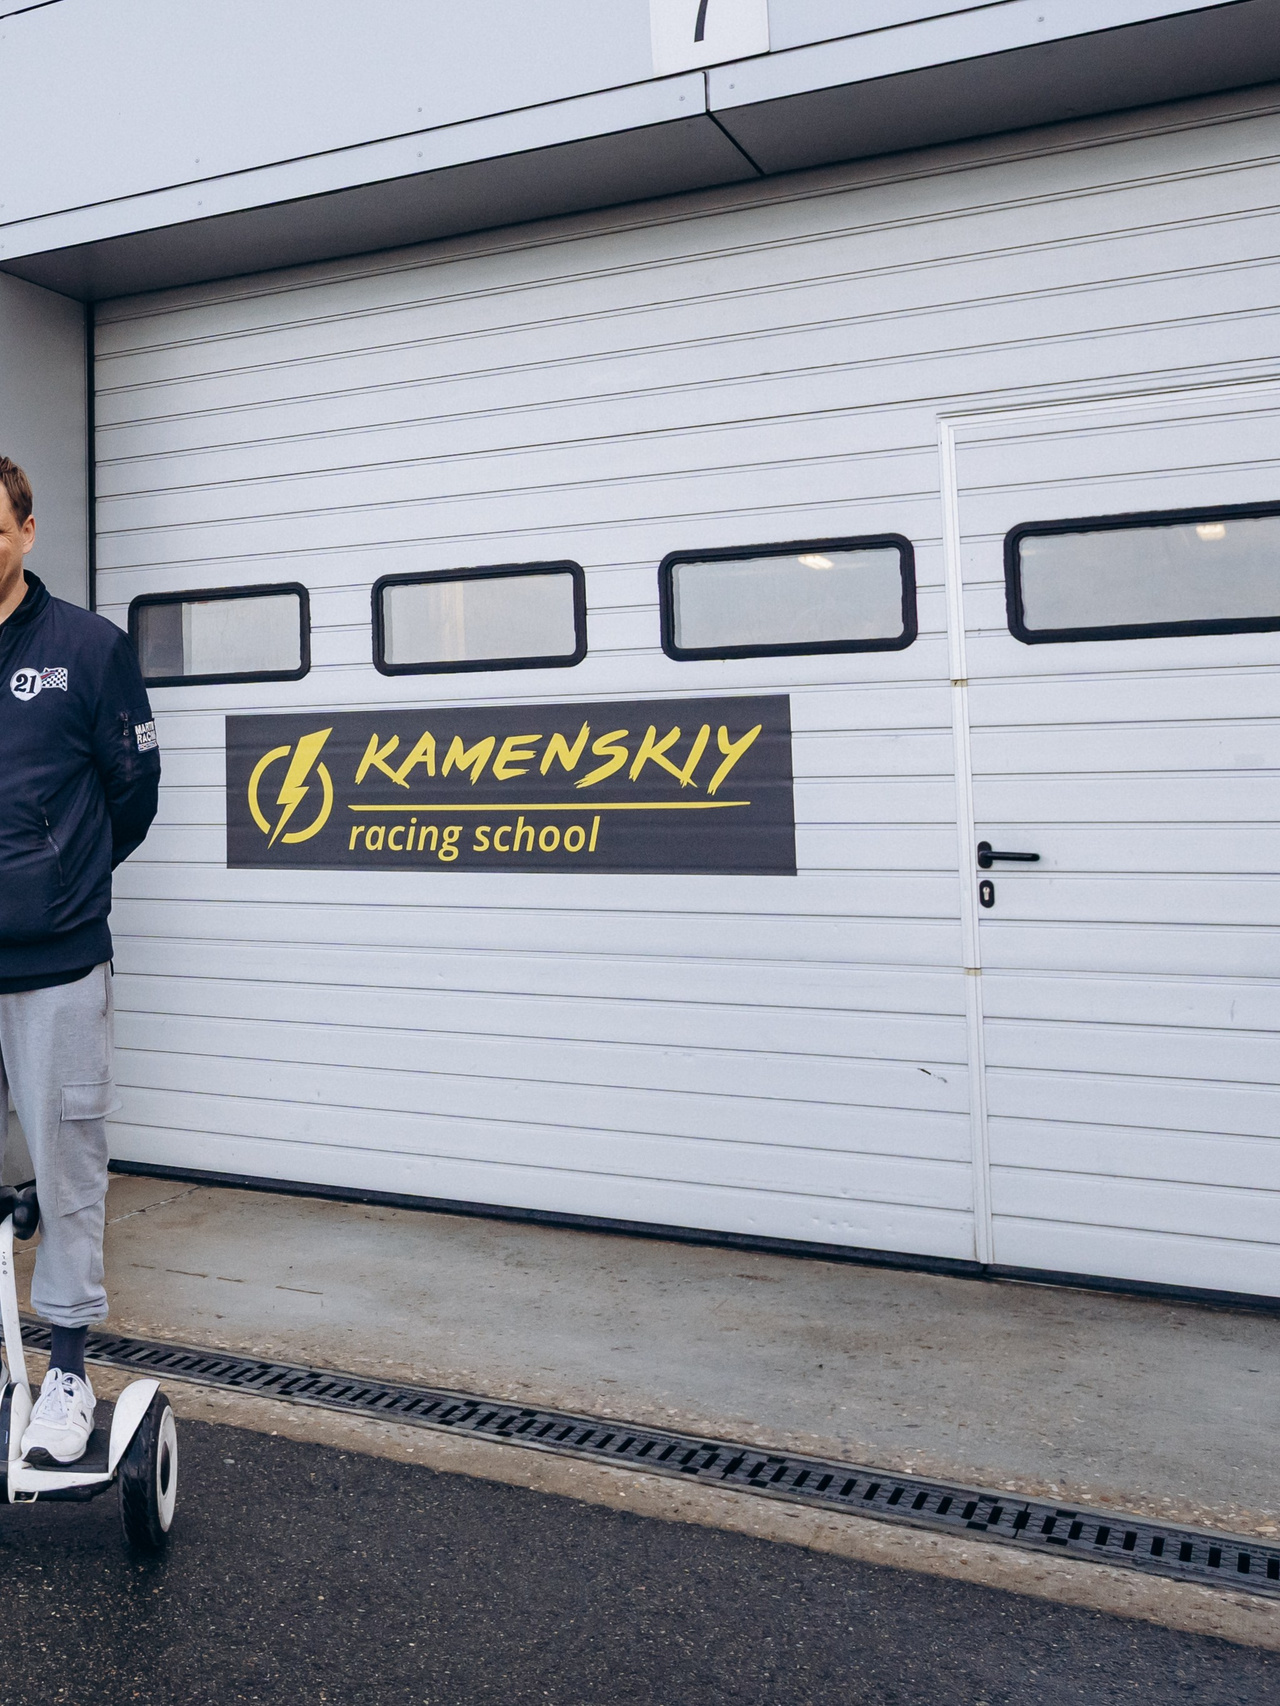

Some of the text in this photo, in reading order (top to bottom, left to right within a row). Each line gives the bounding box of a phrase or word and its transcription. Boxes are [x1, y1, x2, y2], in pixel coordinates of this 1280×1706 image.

[13, 673, 37, 694] 21
[354, 721, 763, 796] KAMENSKIY
[349, 816, 601, 861] racing school
